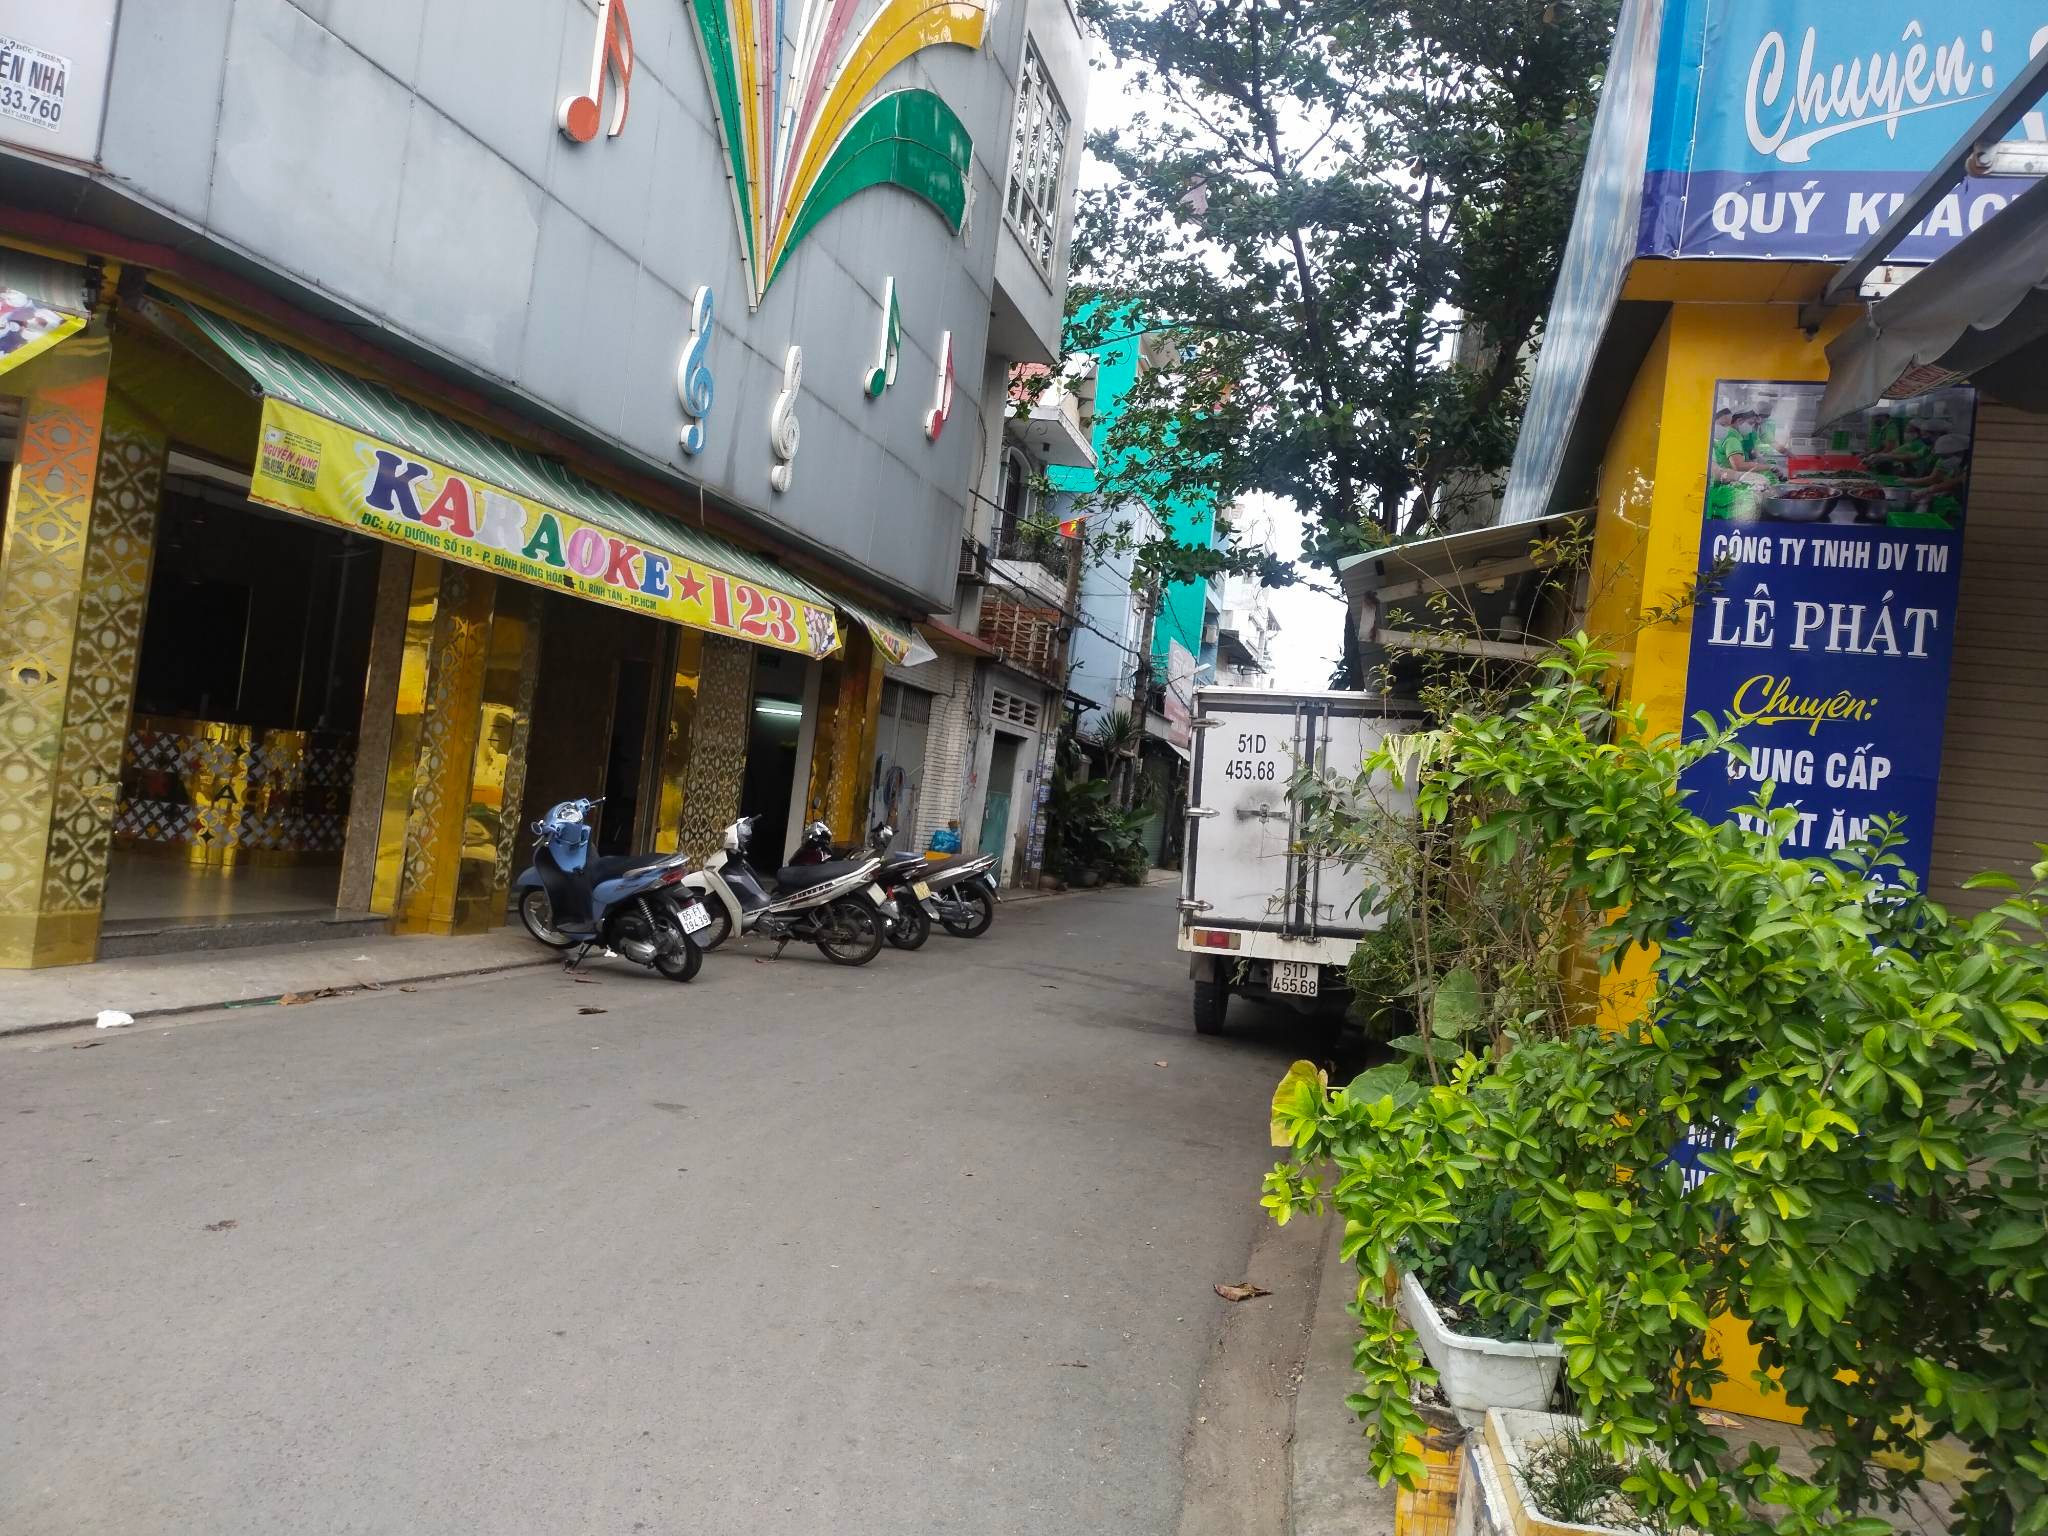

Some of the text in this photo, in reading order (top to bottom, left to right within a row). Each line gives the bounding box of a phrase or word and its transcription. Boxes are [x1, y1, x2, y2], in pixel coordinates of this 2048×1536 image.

[28, 60, 66, 97] NHÀ
[1745, 20, 1994, 156] Chuyên:
[0, 85, 62, 122] 33.760
[1712, 180, 1825, 240] QUÝ
[361, 512, 384, 530] ĐC:
[387, 520, 402, 535] 47
[443, 538, 458, 553] SỐ
[461, 545, 472, 557] 18
[482, 551, 491, 563] P.
[630, 594, 657, 611] TP.HCM
[366, 450, 798, 644] KARAOKE 123
[1713, 529, 1949, 573] CÔNG TY TNHH DV TM
[1708, 583, 1938, 658] LÊ PHÁT
[1733, 674, 1878, 737] Chuyên:
[1238, 734, 1266, 753] 51D
[1226, 760, 1274, 780] 455.68
[1825, 743, 1891, 791] CẤP
[1273, 977, 1317, 994] 455.68
[1284, 963, 1308, 978] 51D
